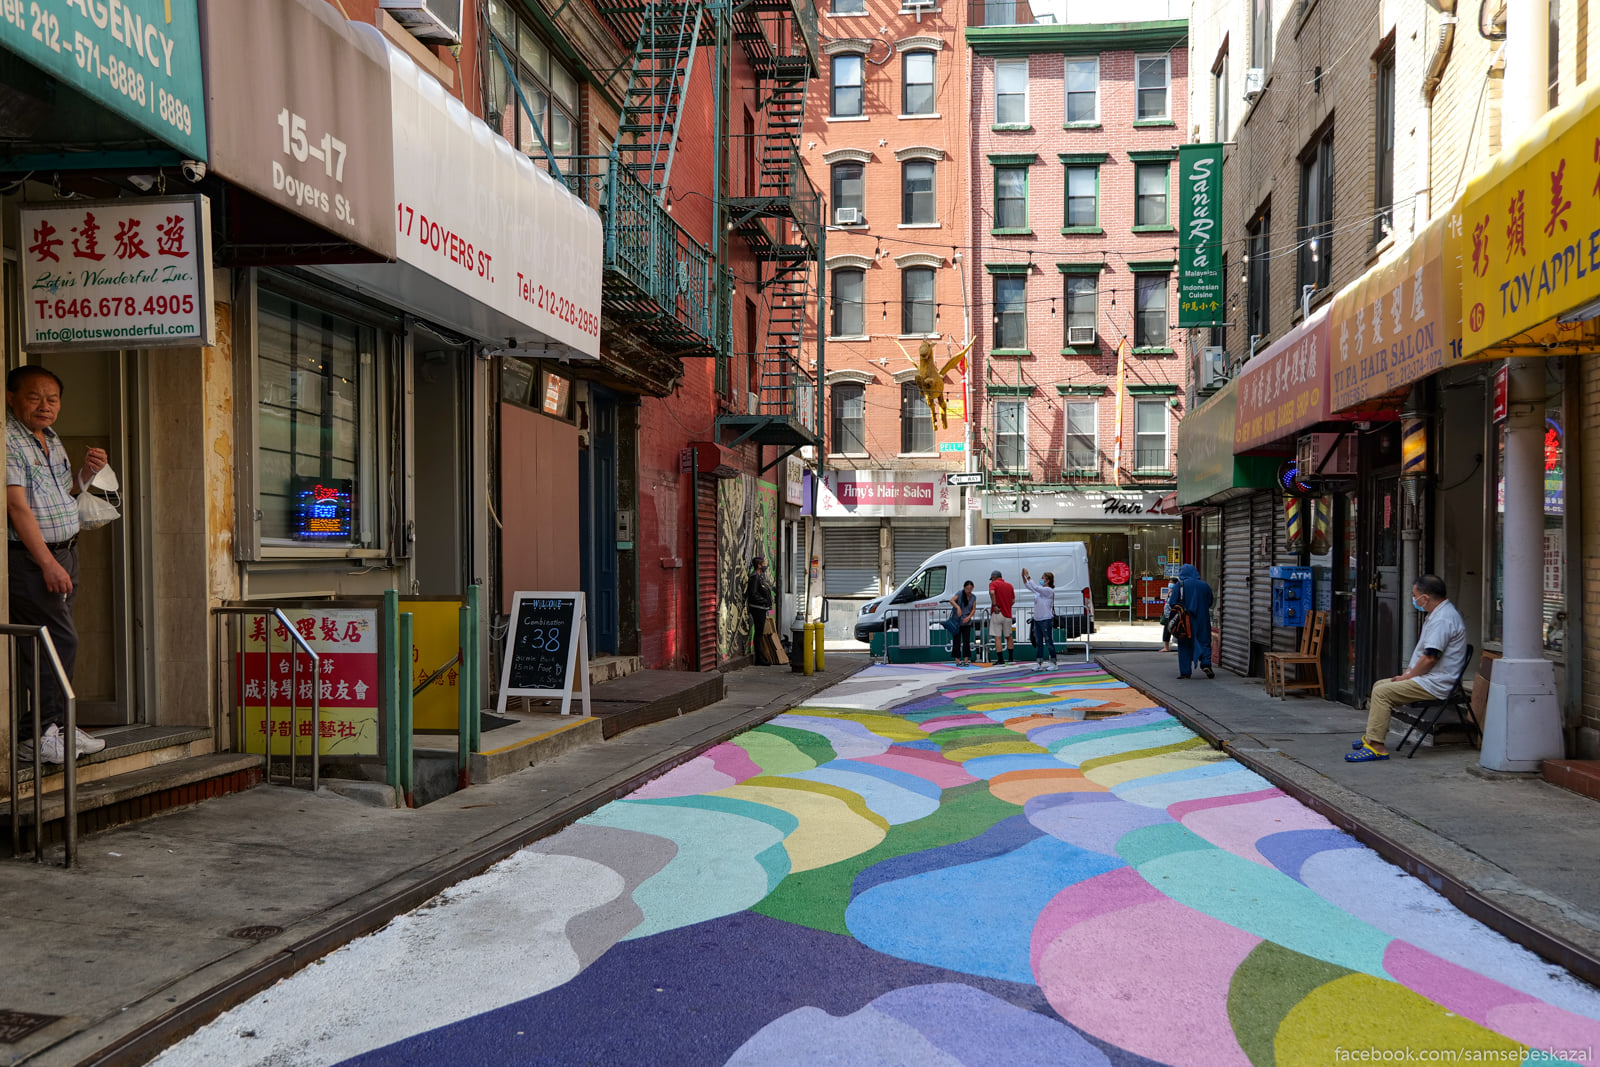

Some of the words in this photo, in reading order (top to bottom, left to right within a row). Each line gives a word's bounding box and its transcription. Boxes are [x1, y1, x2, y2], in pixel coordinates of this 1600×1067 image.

[0, 0, 25, 31] el:
[30, 2, 146, 107] 212-571-8888
[159, 88, 192, 136] 8889
[278, 108, 347, 183] 15-17
[272, 161, 329, 213] Doyers
[334, 198, 355, 225] St.
[28, 212, 190, 262] 安達旅遊
[32, 270, 77, 290] Lotus
[81, 266, 158, 288] Wonderful
[162, 265, 193, 282] Inc.
[398, 203, 414, 236] 17
[420, 215, 474, 271] DOYERS
[478, 250, 495, 283] ST.
[517, 272, 535, 304] Tel:
[538, 285, 598, 337] 212-226-2959
[35, 295, 194, 319] T:646.678.4905
[35, 323, 195, 342] info@lotuswonderful.com
[1334, 371, 1344, 393] YI
[1346, 364, 1357, 388] FA
[1360, 348, 1388, 381] HAIR
[1391, 321, 1435, 367] SALON
[1400, 348, 1442, 383] 212-374-1072
[940, 443, 957, 451] PELL
[843, 484, 874, 499] Amy's
[877, 484, 900, 498] Hair
[903, 485, 931, 499] Salon
[1102, 497, 1142, 515] Hair
[1290, 572, 1311, 580] ATM
[531, 627, 560, 652] 38
